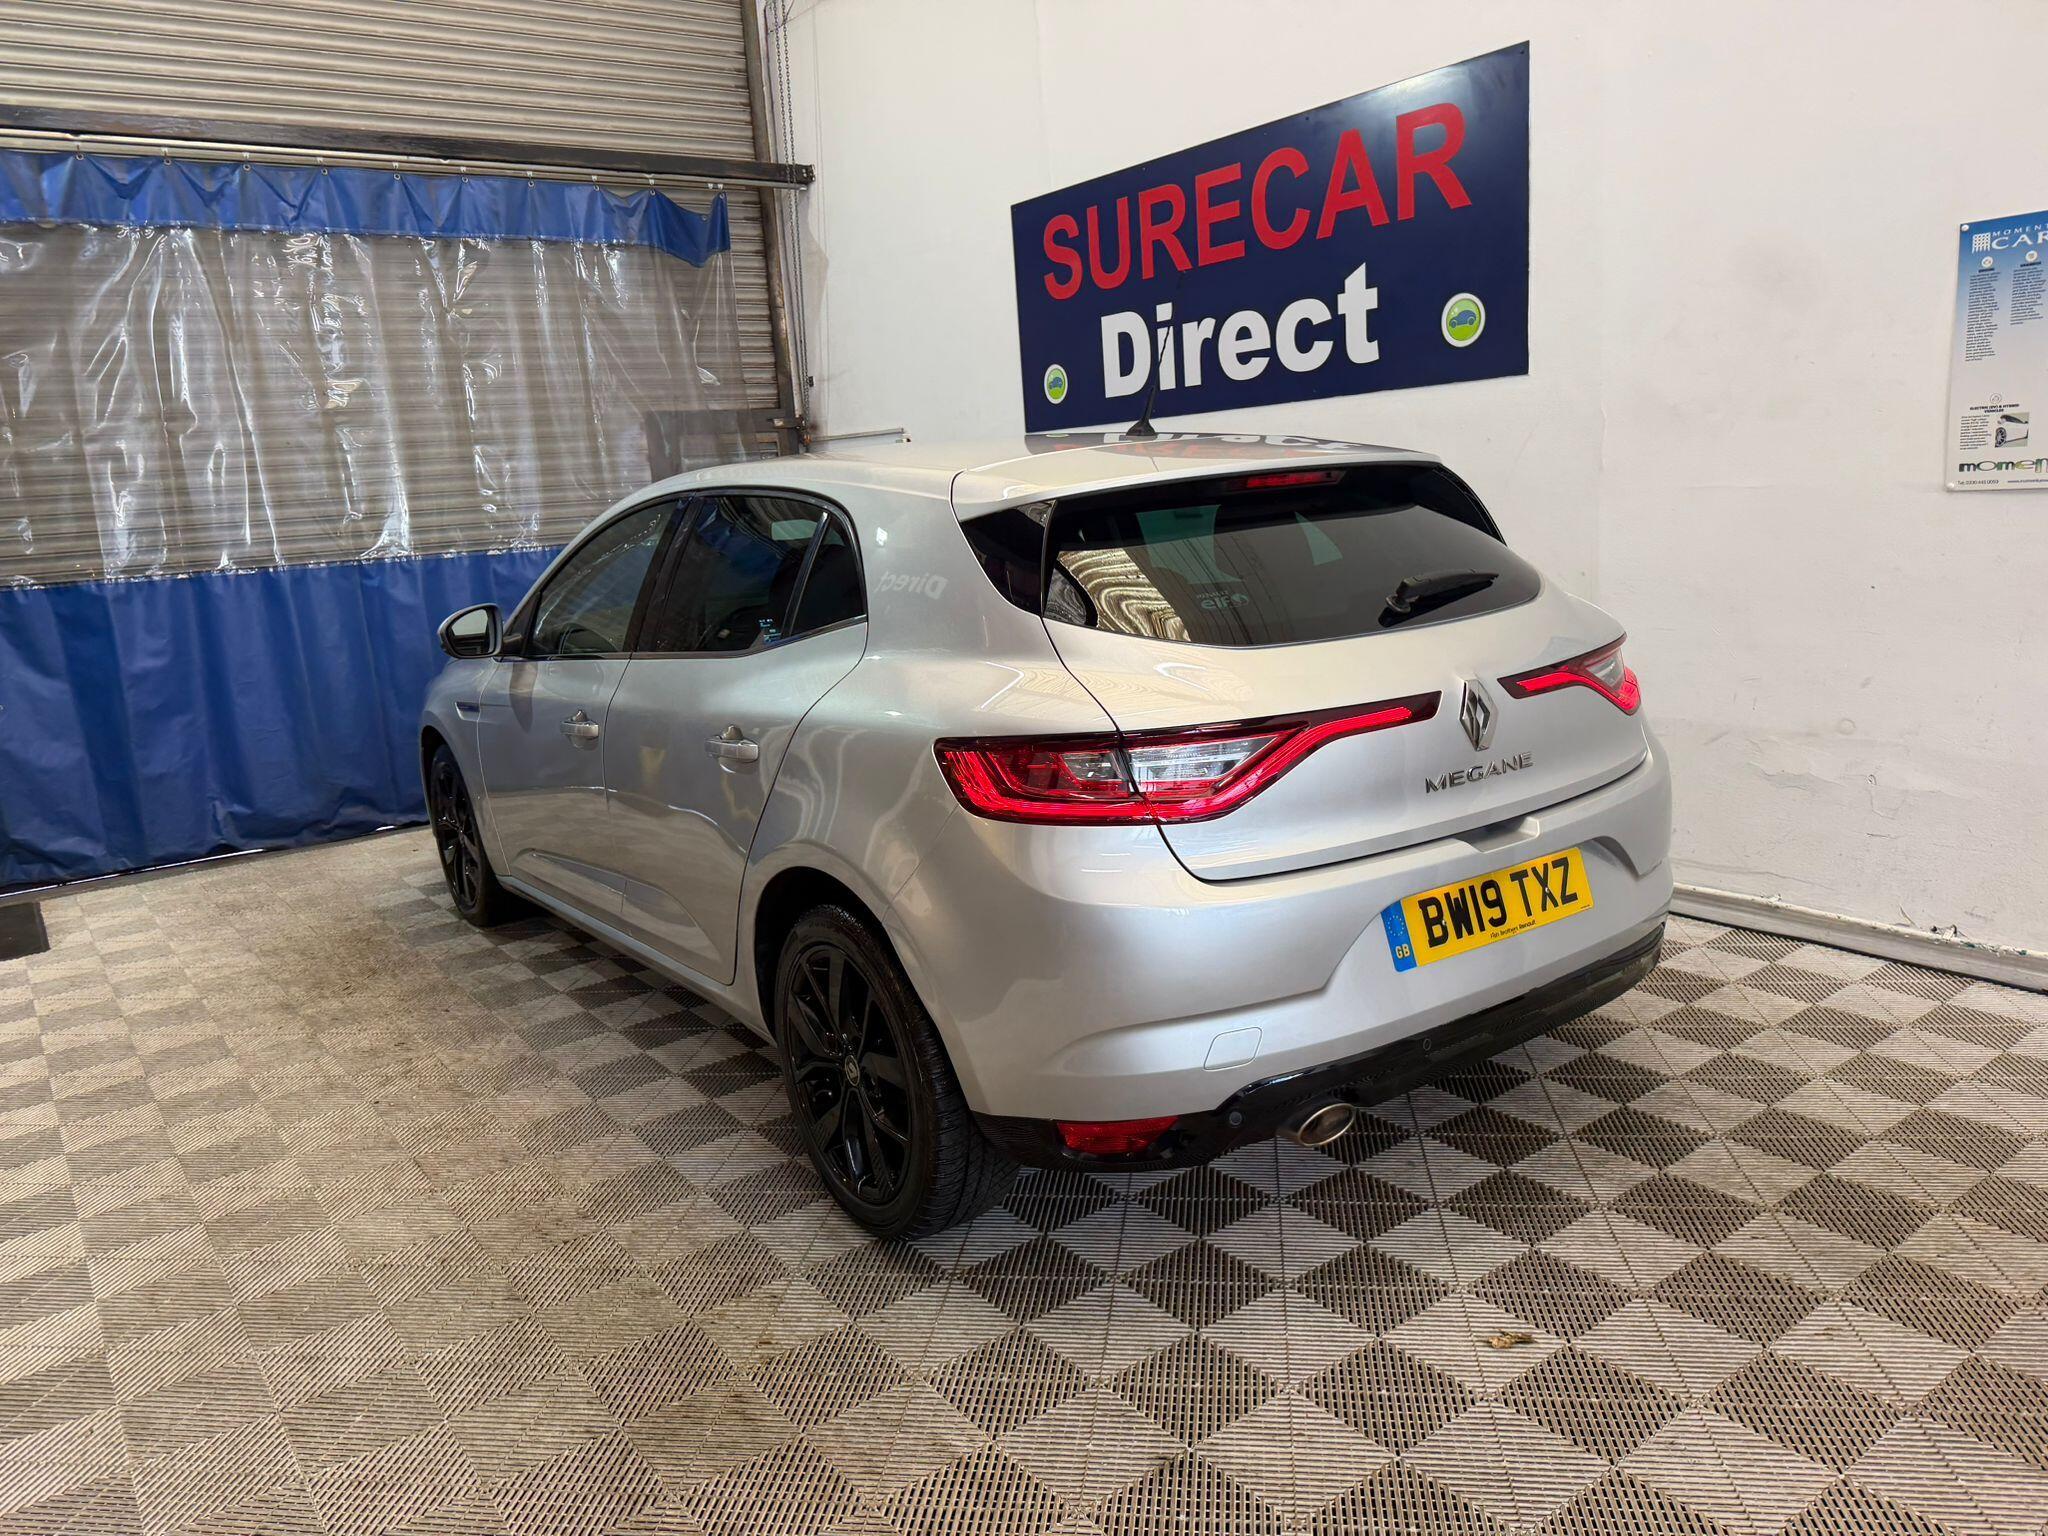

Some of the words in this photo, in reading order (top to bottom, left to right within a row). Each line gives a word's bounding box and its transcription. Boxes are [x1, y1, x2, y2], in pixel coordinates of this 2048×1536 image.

[1043, 102, 1472, 300] SURECAR
[1101, 262, 1380, 398] Direct
[1425, 751, 1534, 794] MEGANE
[1417, 879, 1507, 948] BW19
[1509, 857, 1579, 917] TXZ
[1395, 943, 1410, 959] GB
